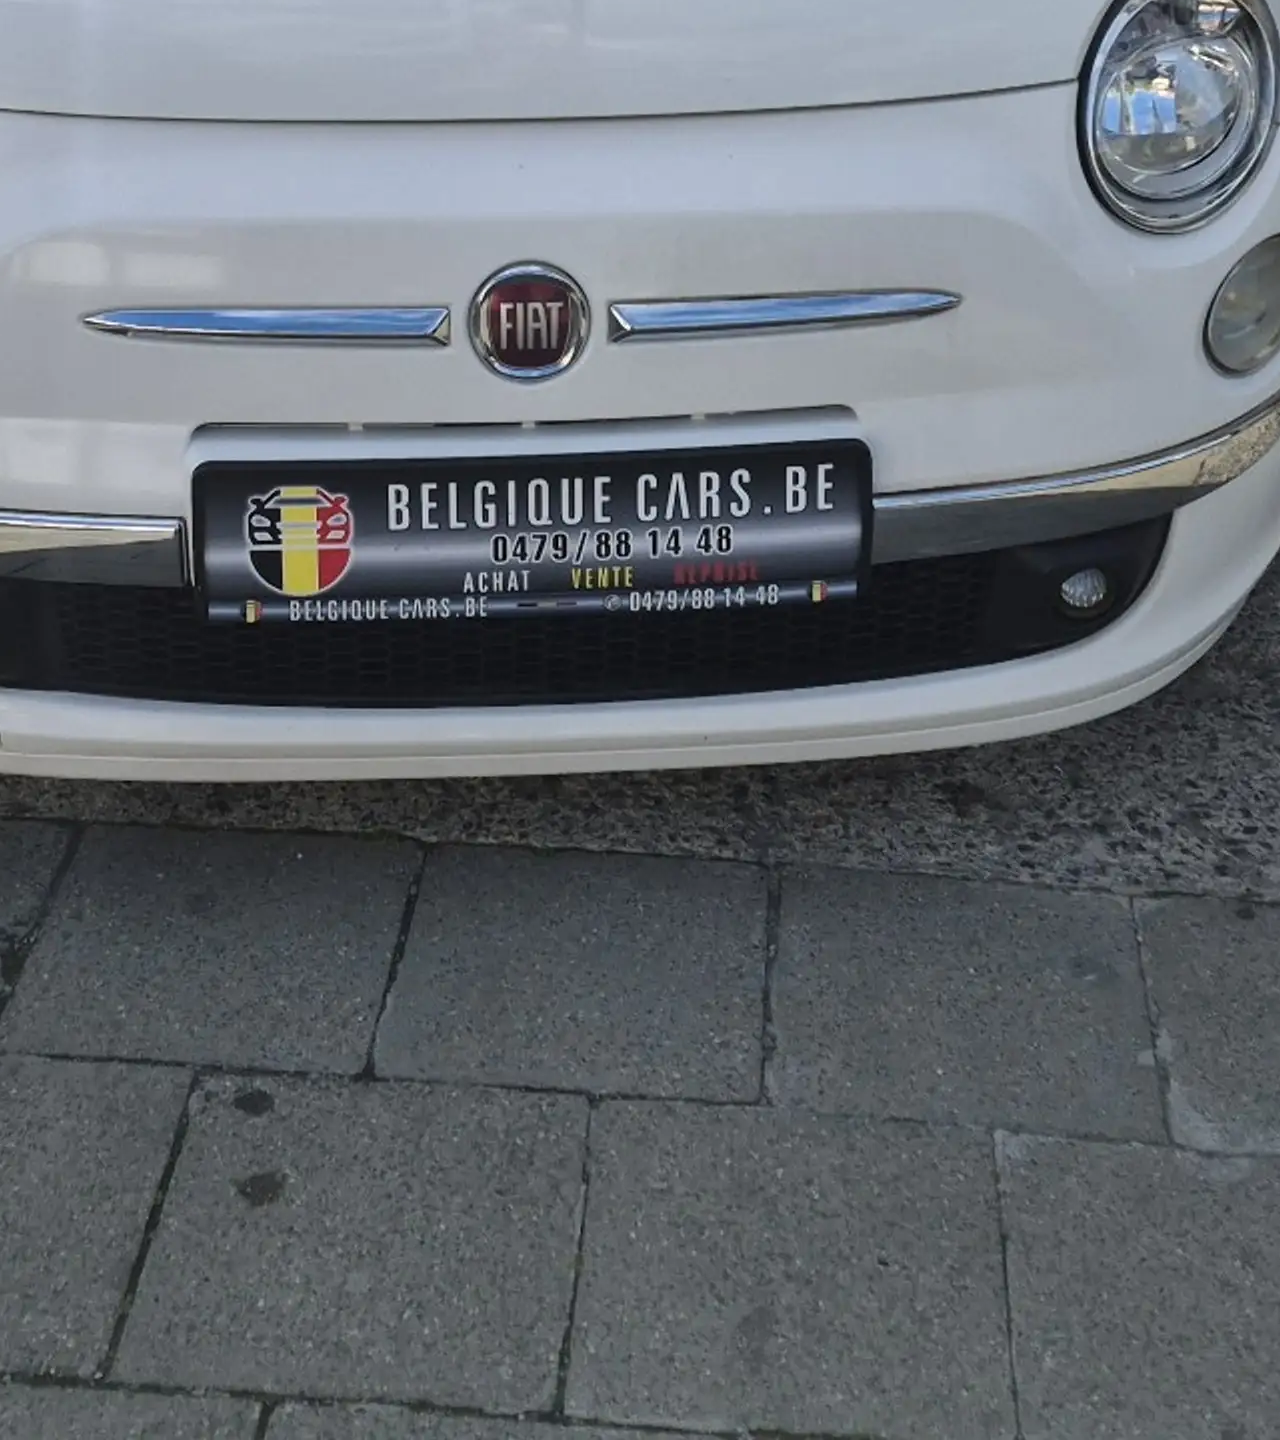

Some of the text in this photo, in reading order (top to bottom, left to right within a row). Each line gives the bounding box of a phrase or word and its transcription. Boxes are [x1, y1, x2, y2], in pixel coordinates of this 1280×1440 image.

[500, 302, 564, 350] FIAT
[388, 476, 612, 530] BELGIQUE
[491, 524, 734, 565] 0479/88 14 48
[463, 570, 531, 593] ACHAT
[572, 566, 634, 589] VENTE
[290, 599, 389, 621] BELGIQUE
[629, 584, 778, 612] 0479/88 14 48
